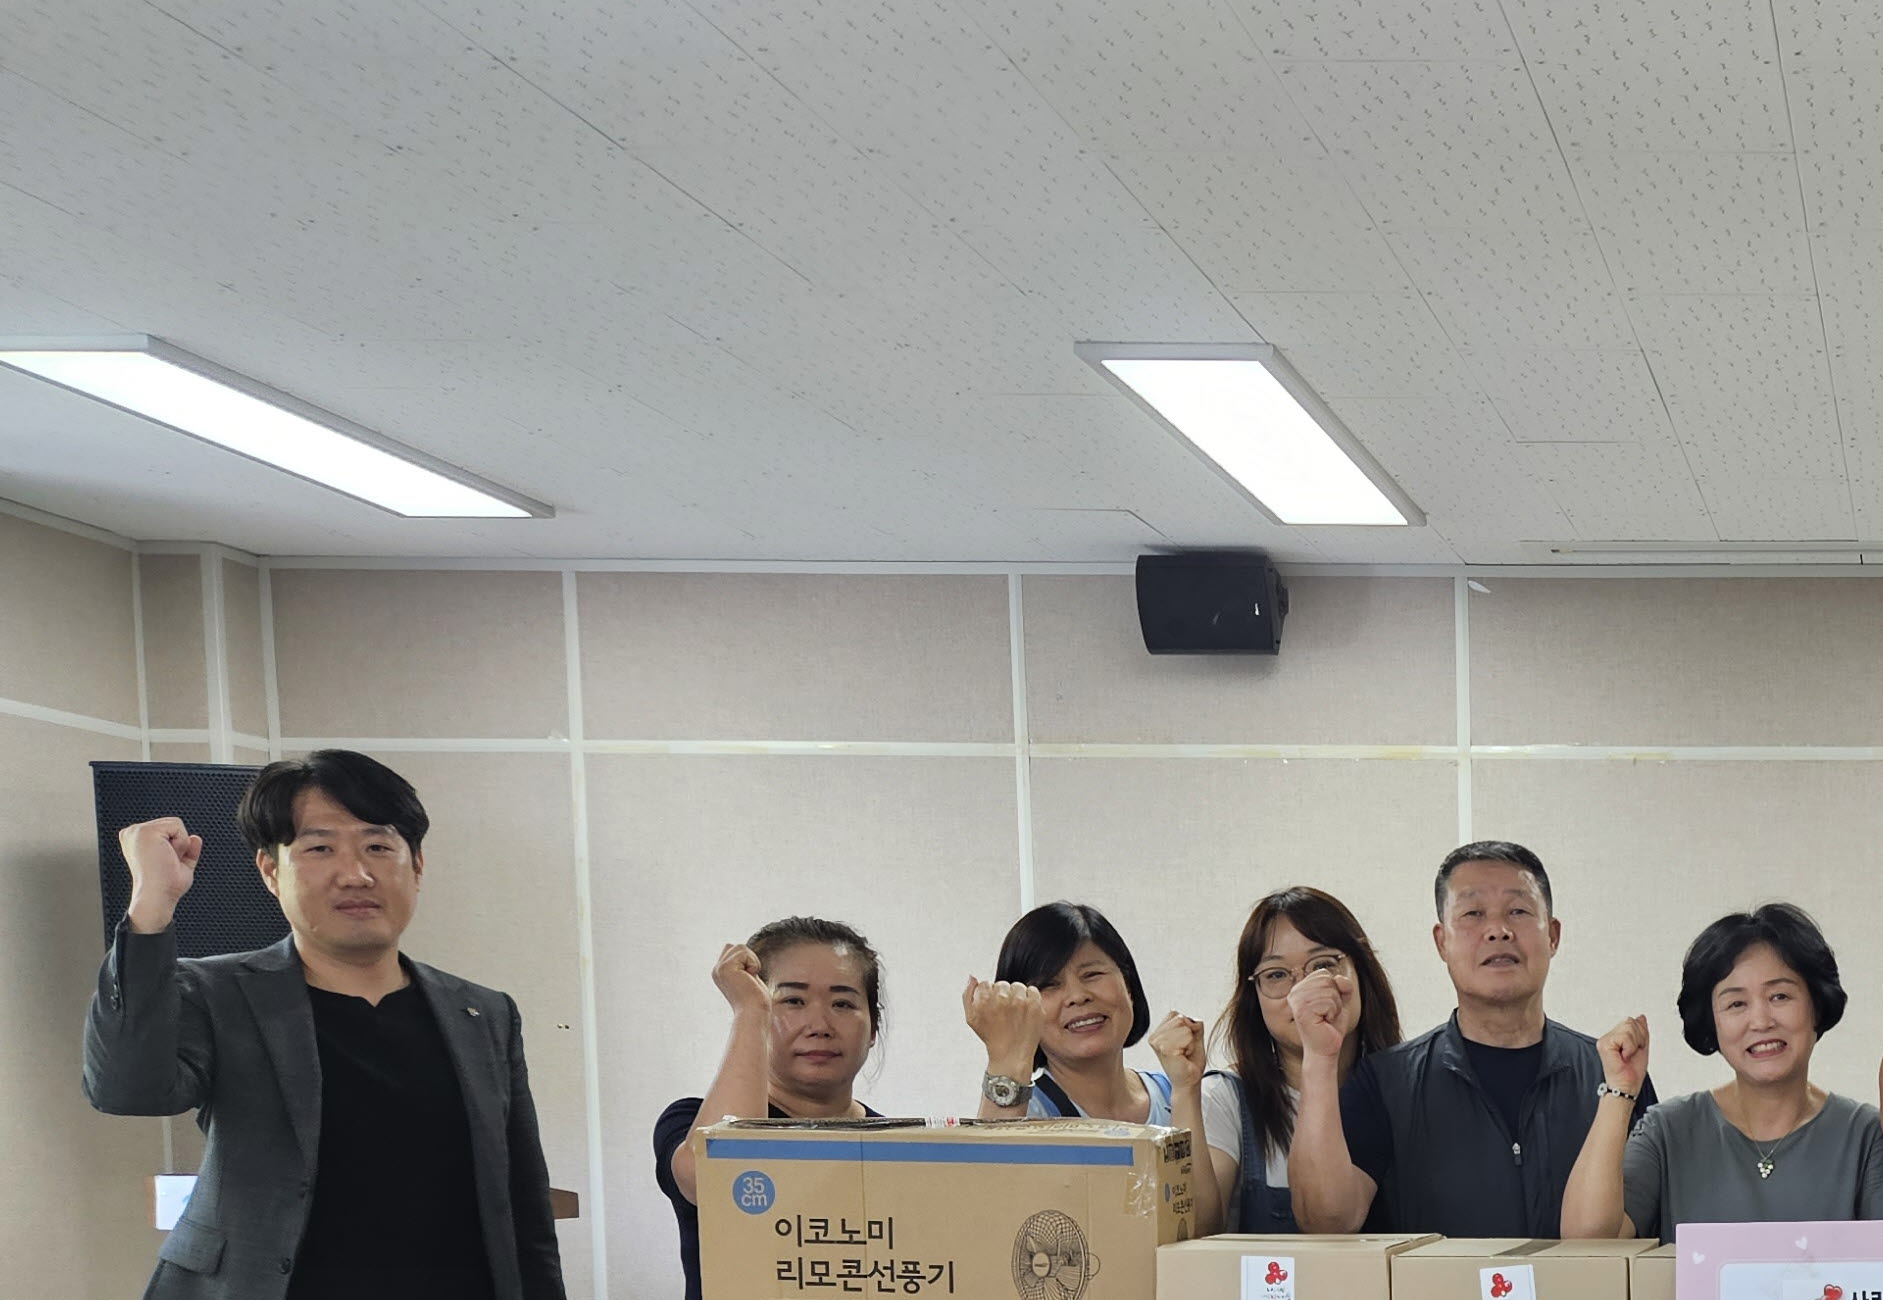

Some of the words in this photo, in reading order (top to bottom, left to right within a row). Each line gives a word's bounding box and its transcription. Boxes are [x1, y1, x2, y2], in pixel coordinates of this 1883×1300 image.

[742, 1178, 765, 1193] 35
[740, 1193, 767, 1207] cm
[774, 1215, 893, 1249] 이코노미
[776, 1257, 954, 1294] 리모콘선풍기
